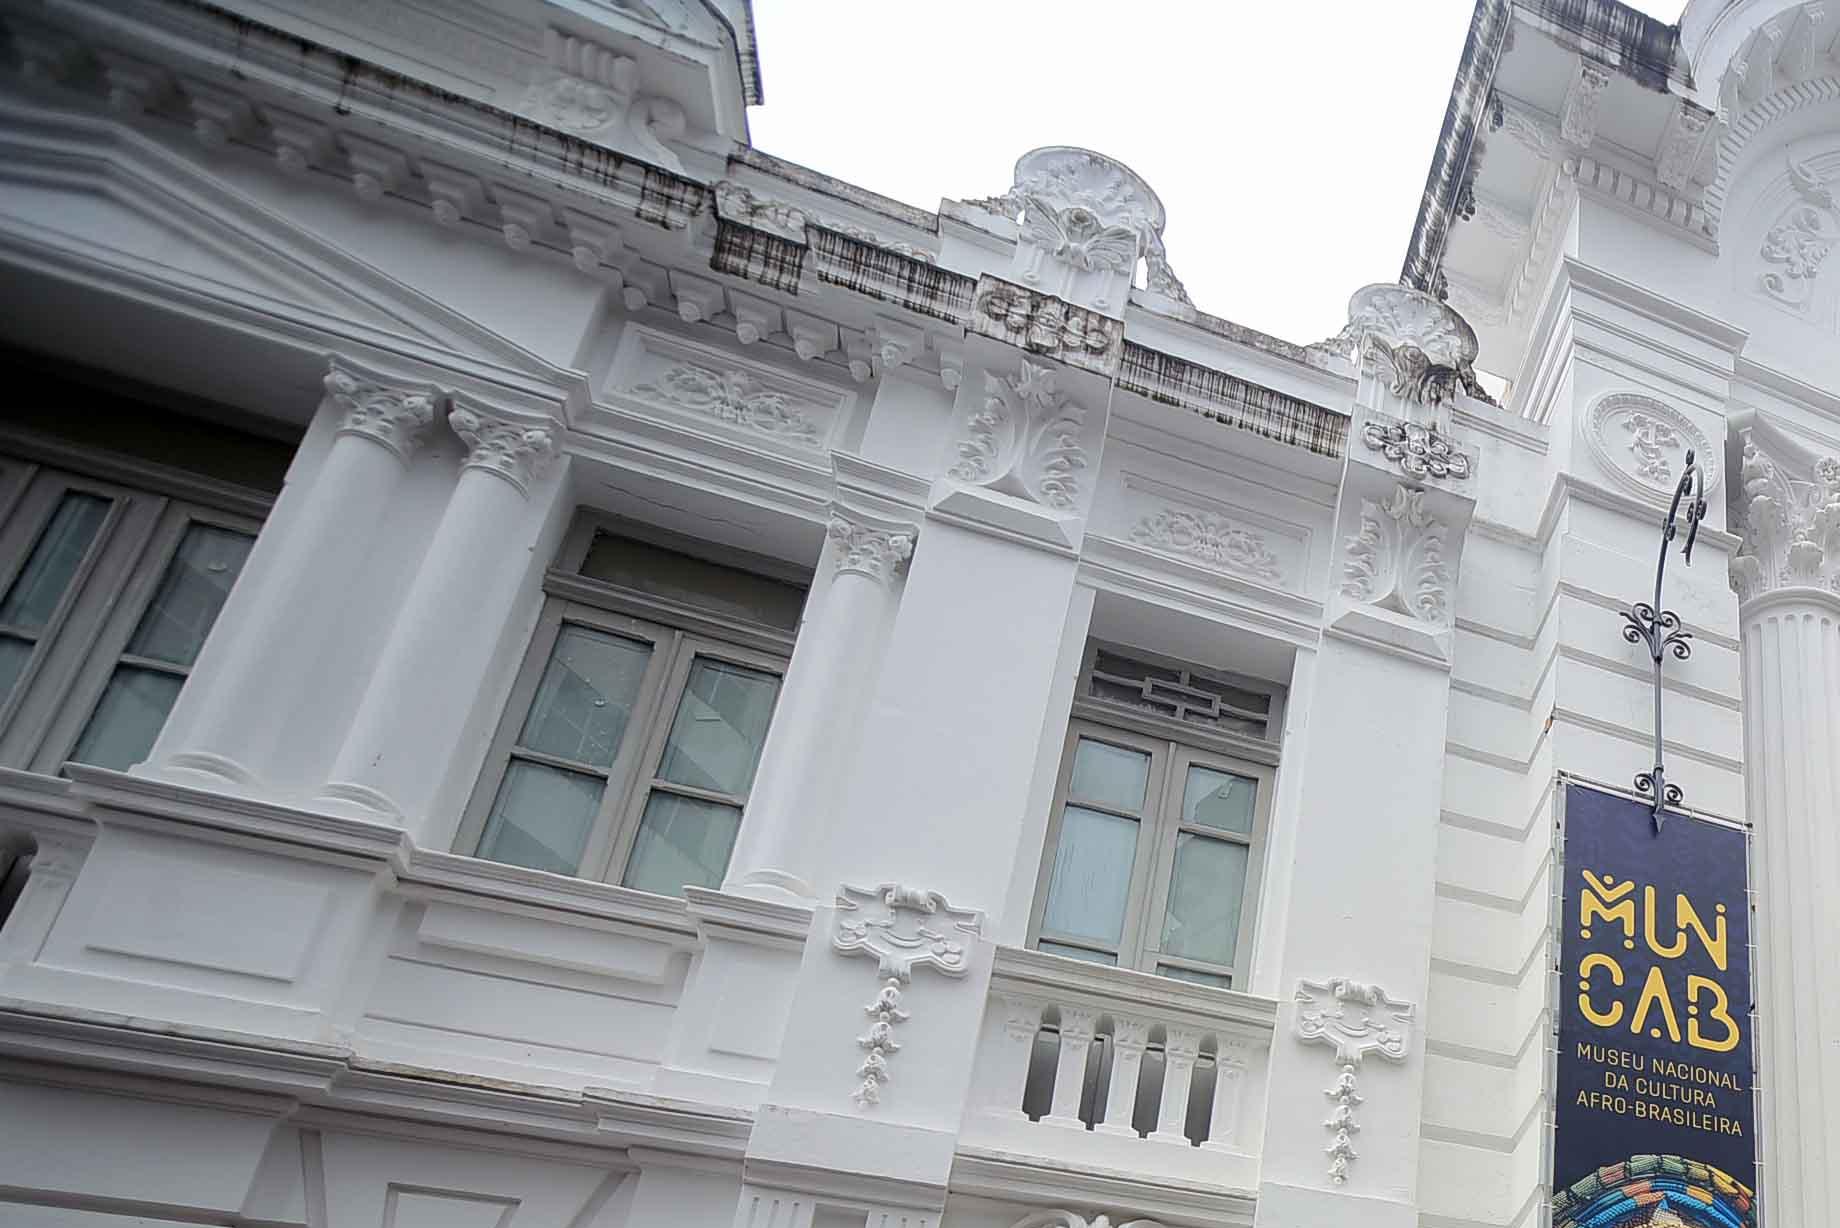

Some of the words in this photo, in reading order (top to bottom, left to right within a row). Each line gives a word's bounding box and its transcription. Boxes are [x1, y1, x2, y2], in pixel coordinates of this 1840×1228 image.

[1580, 869, 1728, 972] MUN
[1578, 952, 1740, 1052] CAB
[1577, 1042, 1645, 1071] MUSEU
[1652, 1058, 1744, 1091] NACIONAL
[1605, 1071, 1629, 1091] DA
[1635, 1077, 1716, 1109] CULTURA
[1576, 1090, 1743, 1137] AFRO-BRASILEIRA
